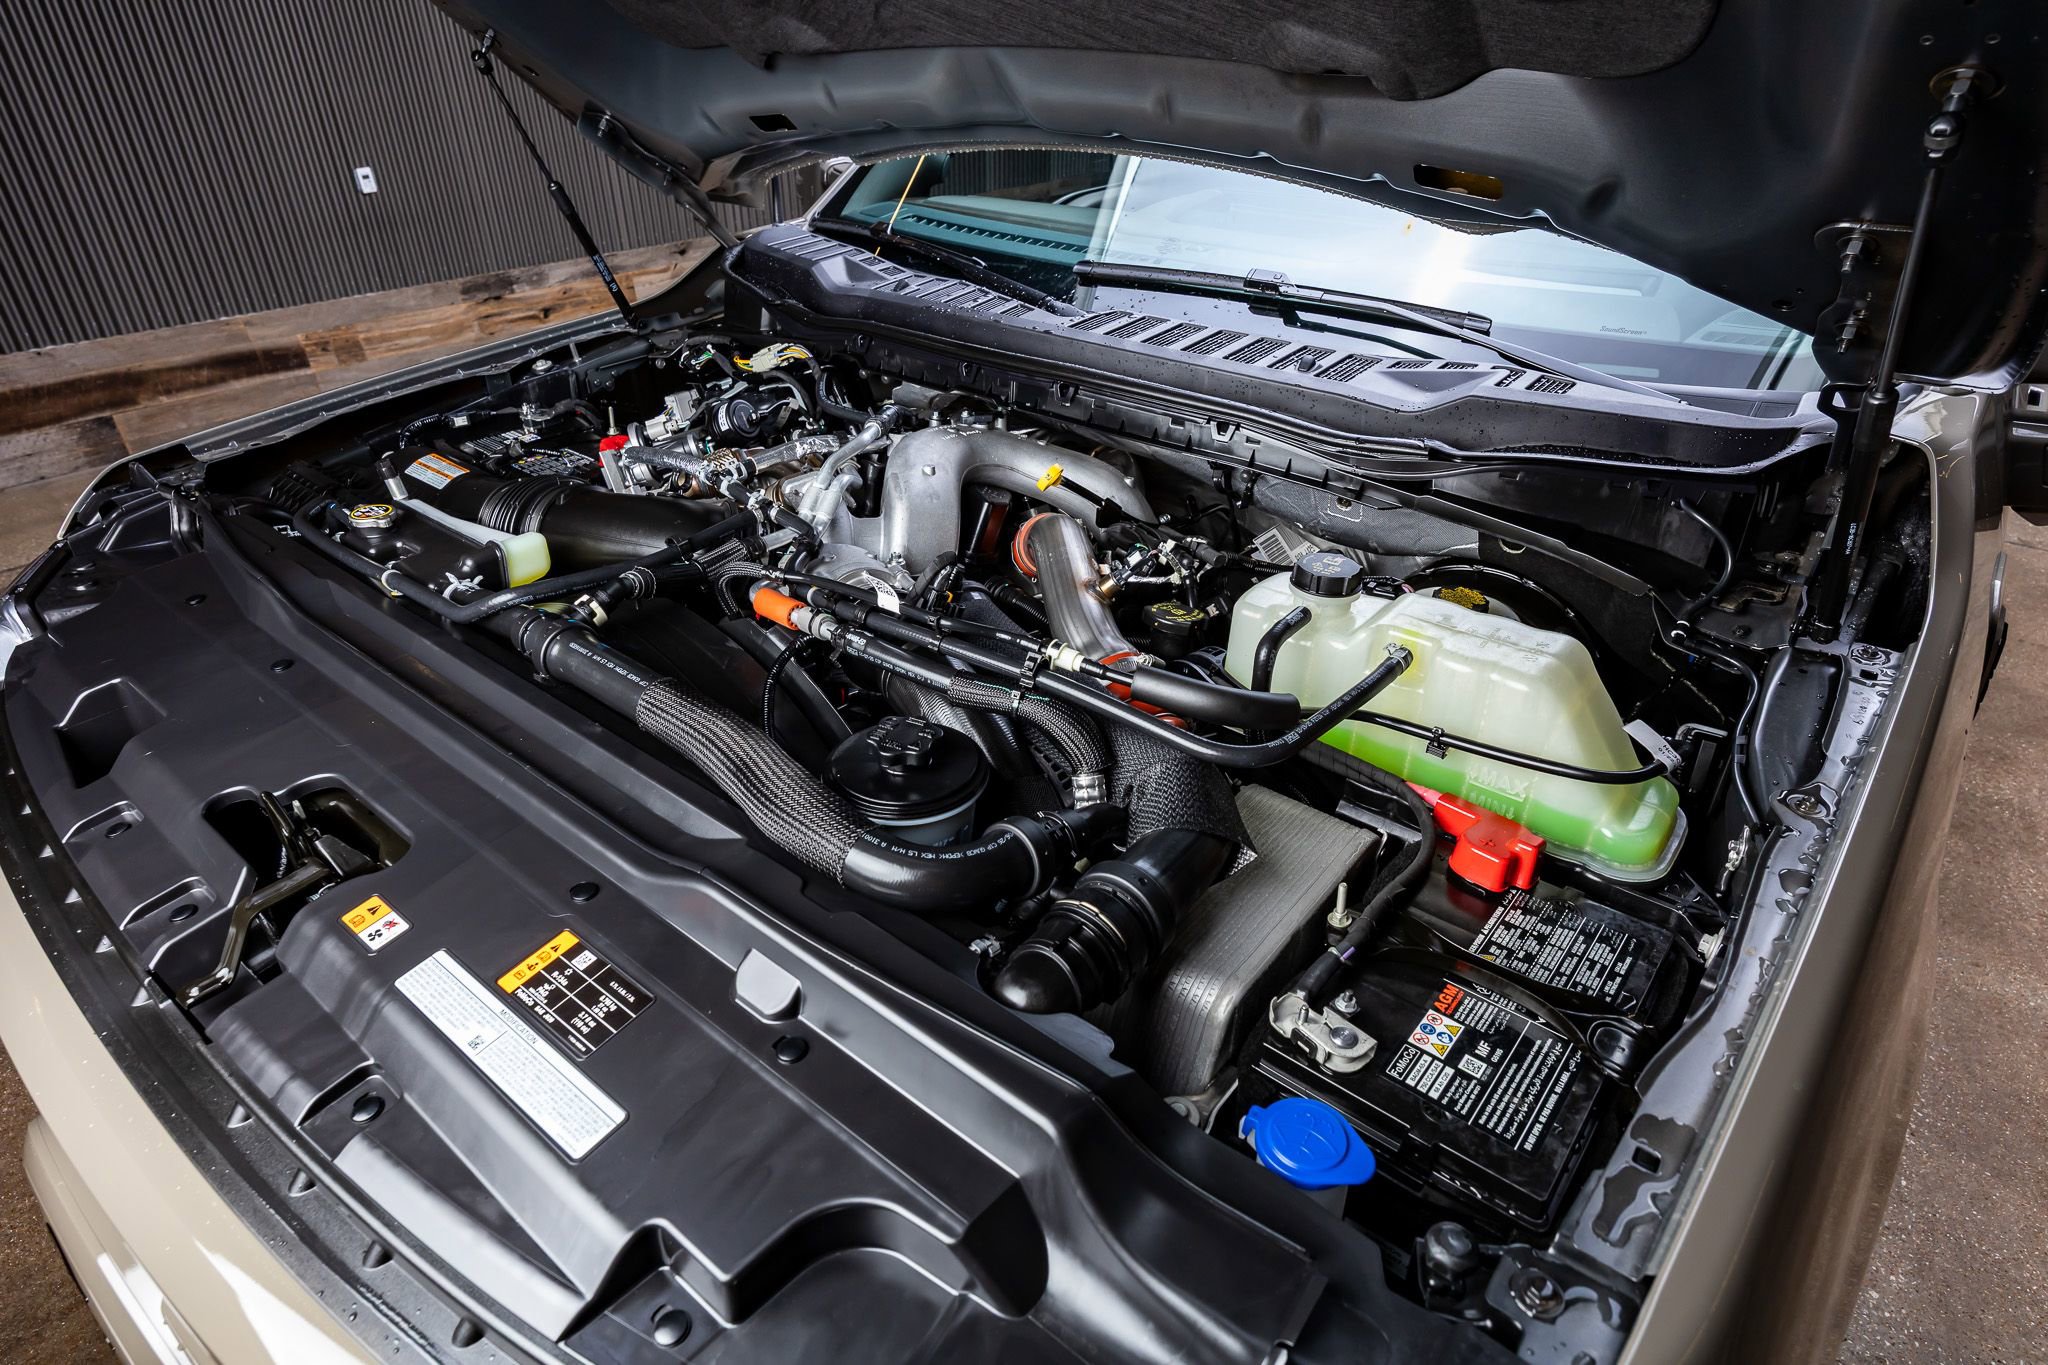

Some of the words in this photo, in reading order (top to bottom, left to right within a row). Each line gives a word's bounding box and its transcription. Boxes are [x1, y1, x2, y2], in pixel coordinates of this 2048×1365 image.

[514, 988, 535, 1006] FoMoCo
[1432, 984, 1459, 1011] AGM
[500, 1010, 536, 1042] MODIFICATION
[1475, 1040, 1492, 1057] MF
[1390, 1048, 1416, 1076] FoMoCo
[1436, 1079, 1445, 1088] Ah
[1441, 1071, 1450, 1081] C20
[1420, 1081, 1429, 1090] 750
[1432, 1085, 1441, 1094] 68
